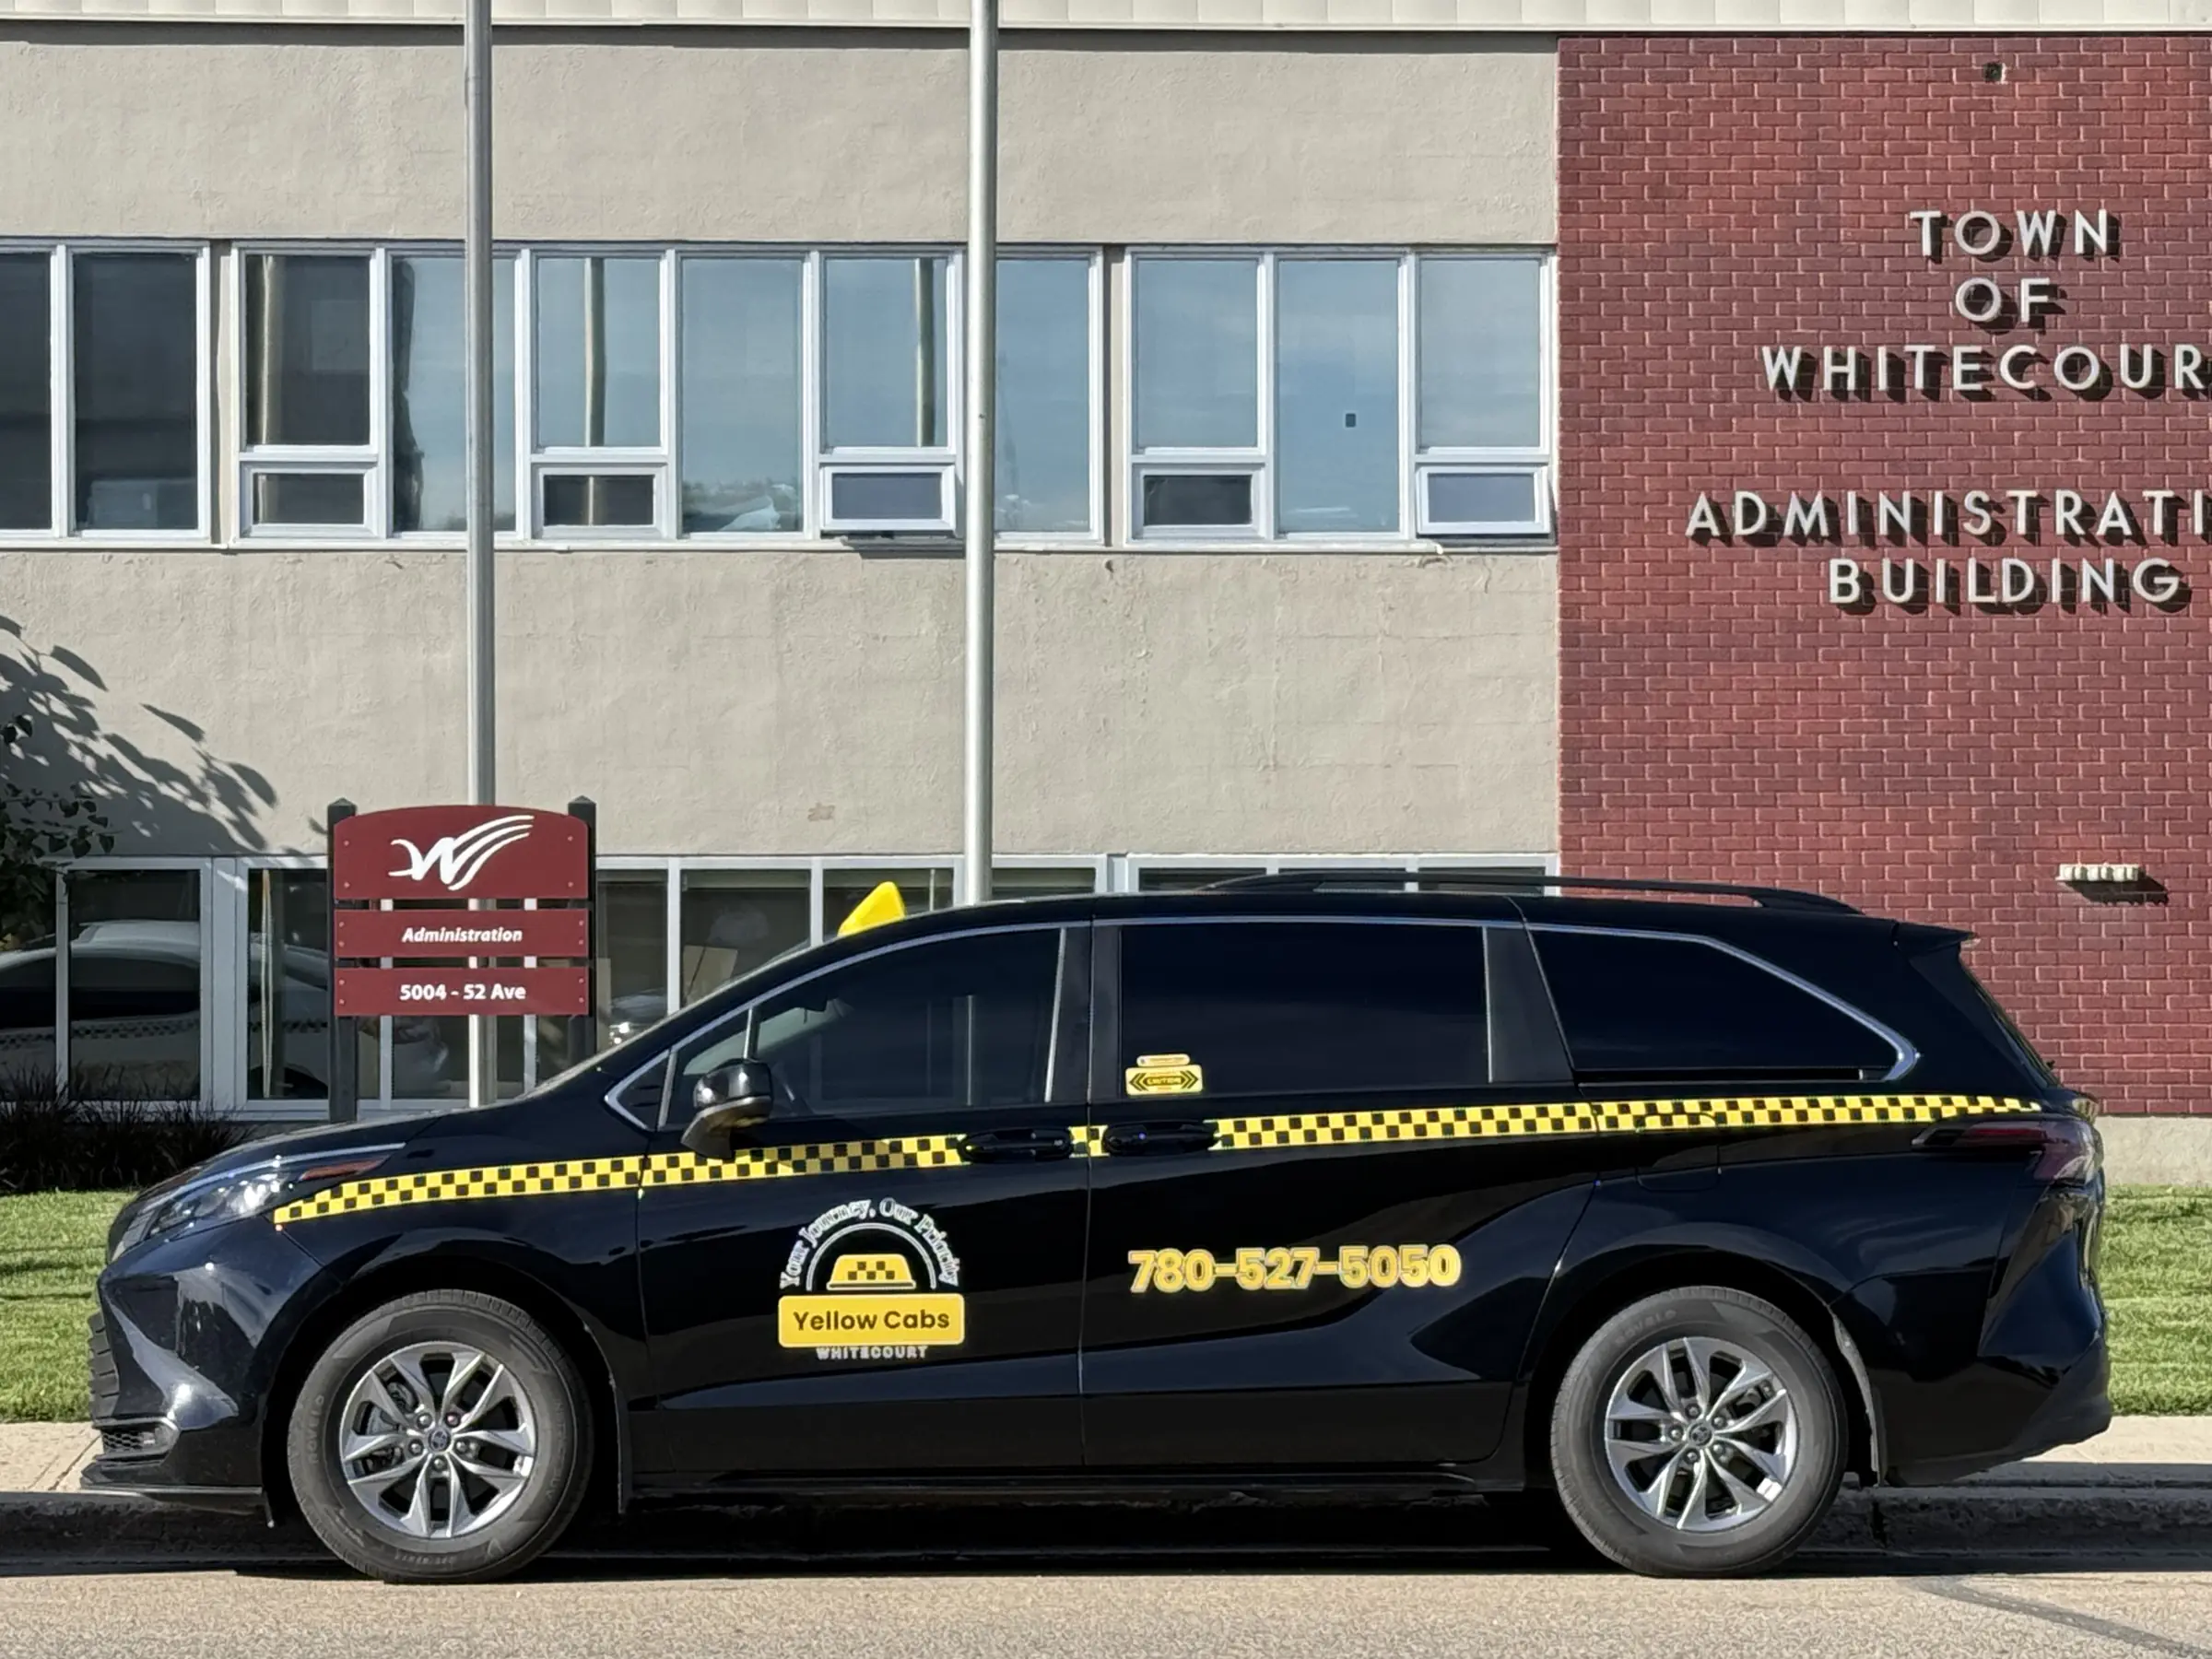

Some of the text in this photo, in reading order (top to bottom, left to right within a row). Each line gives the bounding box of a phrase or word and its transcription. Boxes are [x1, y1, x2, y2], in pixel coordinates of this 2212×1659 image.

[1910, 209, 2109, 256] TOWN
[1955, 277, 2051, 323] OF
[1760, 345, 2205, 392] WHITECOUR
[1685, 490, 2204, 537] ADMINISTRATI
[1830, 558, 2181, 605] BUILDING
[402, 926, 524, 943] Administration
[399, 983, 447, 1000] 5004
[464, 983, 487, 1000] 52
[490, 983, 526, 1000] Ave
[779, 1240, 810, 1289] Your
[879, 1196, 919, 1226] Our
[913, 1213, 960, 1287] Priority
[1127, 1244, 1462, 1293] 780-527-5050
[794, 1309, 949, 1331] Yellow Cabs
[816, 1346, 928, 1360] WHITECOURT
